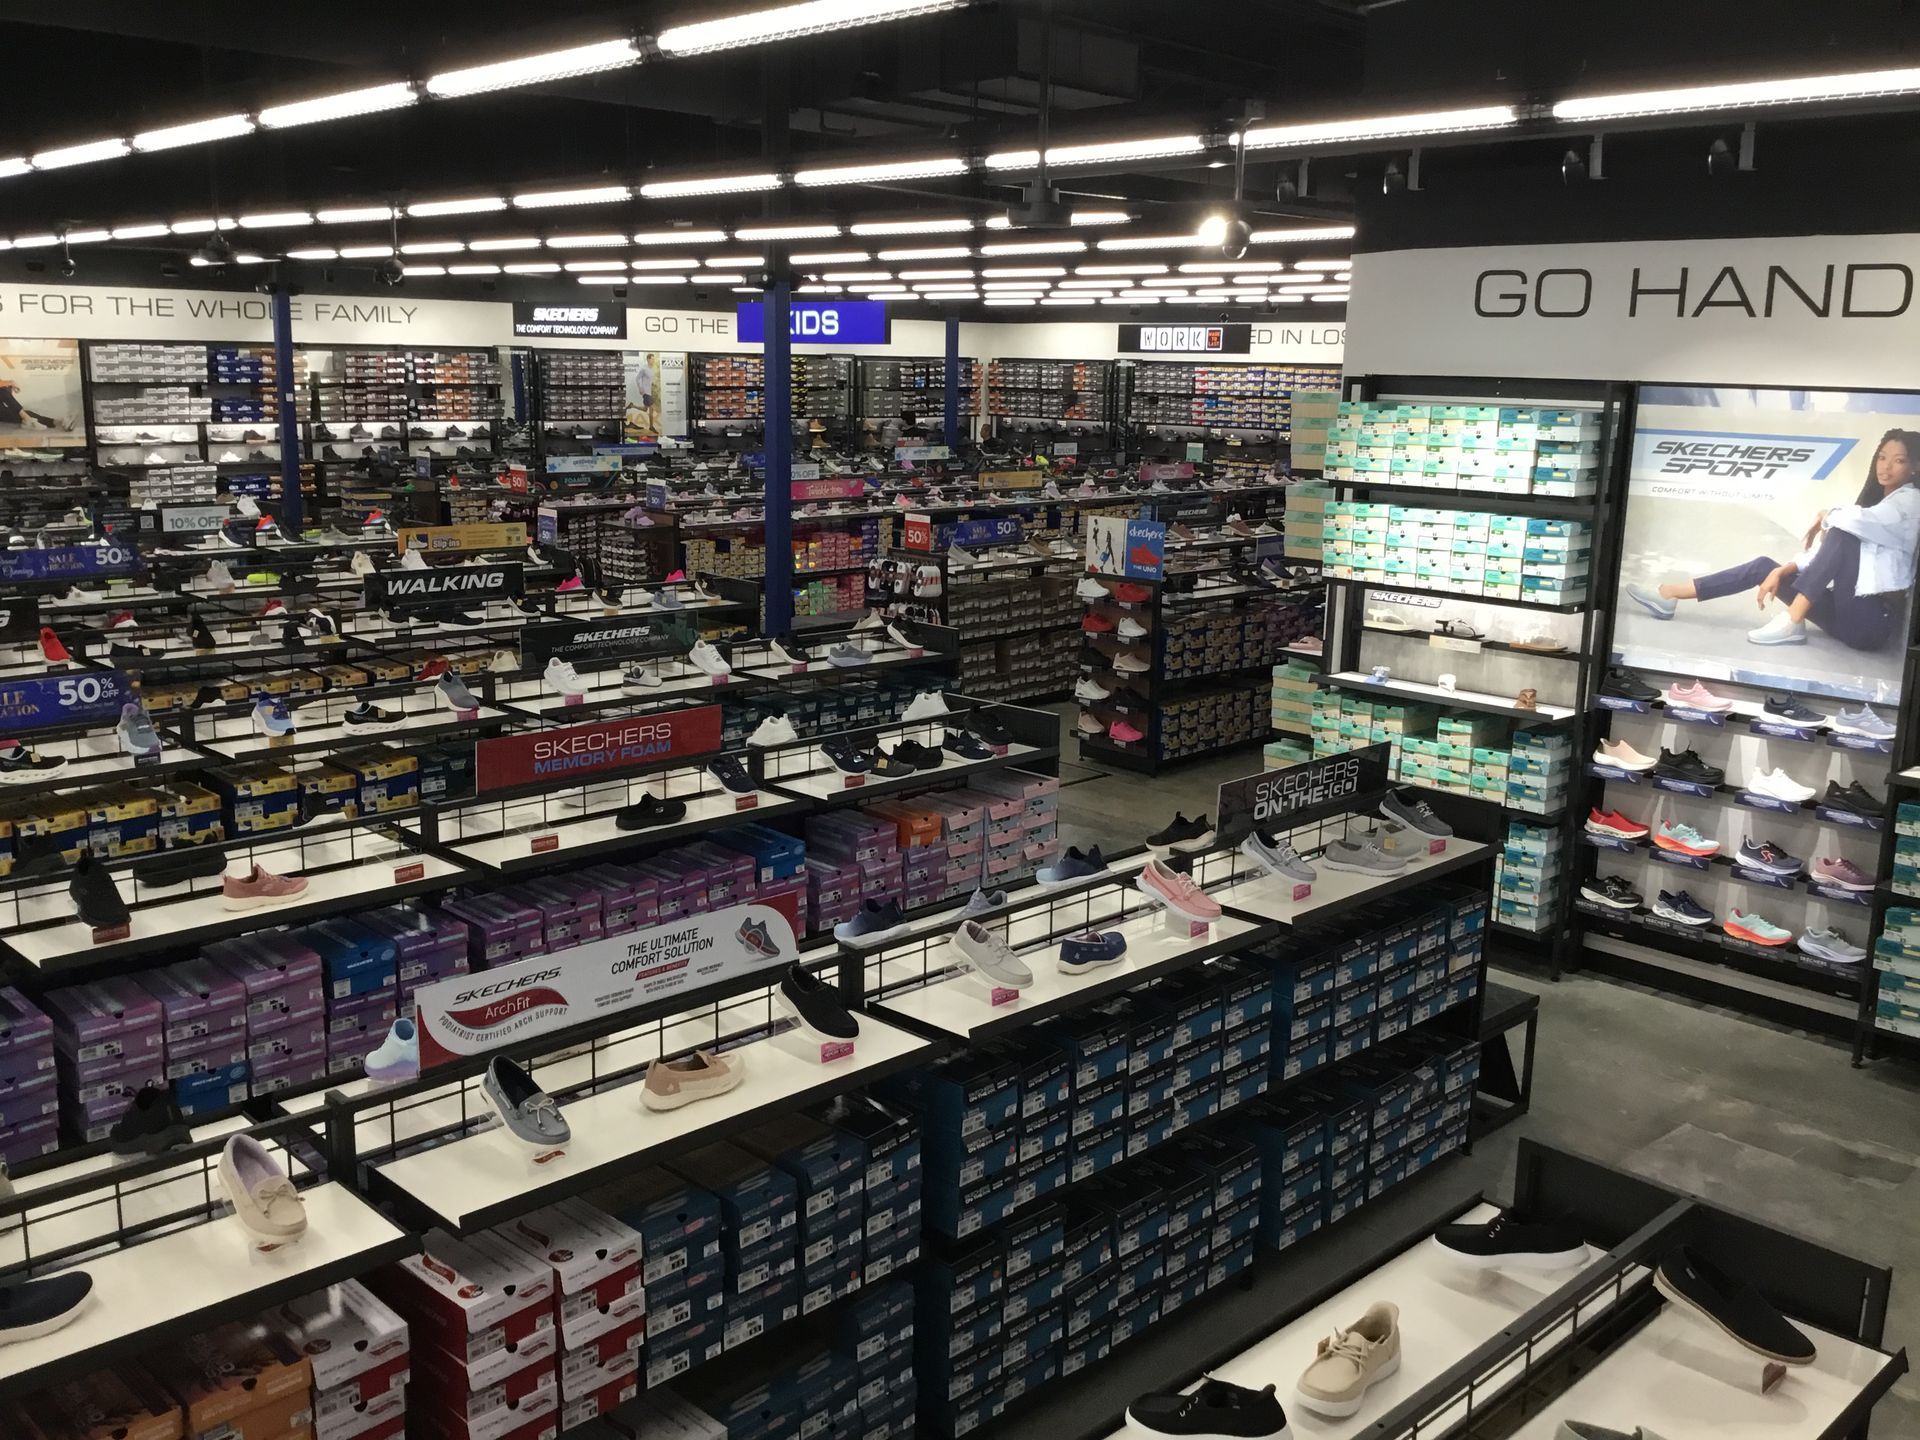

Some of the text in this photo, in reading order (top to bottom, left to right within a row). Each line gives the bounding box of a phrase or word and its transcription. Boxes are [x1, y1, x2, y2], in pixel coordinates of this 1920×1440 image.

[1474, 263, 1914, 318] GO HAND
[19, 293, 93, 315] FOR
[106, 296, 175, 317] THE
[315, 303, 418, 325] FAMILY
[533, 307, 599, 322] SKECHERS
[515, 324, 527, 333] THE
[589, 326, 618, 336] COMPANY
[645, 316, 729, 334] GO THE
[1144, 331, 1202, 347] WORK
[1281, 329, 1302, 344] IN
[1652, 441, 1816, 463] SKECHERS
[1660, 458, 1789, 480] SPORT
[170, 515, 224, 529] 10% OFF
[1129, 525, 1163, 541] skechers
[1142, 566, 1157, 574] UNO
[387, 572, 504, 596] WALKING
[1371, 591, 1443, 609] SKECHERS
[551, 634, 670, 654] THE COMFORT TECHNOLOGY COMPANY
[572, 626, 651, 644] SKECHERS
[101, 689, 120, 699] OFF
[534, 722, 672, 760] SKECHERS
[533, 740, 672, 775] MEMORY FOAM
[1255, 758, 1360, 803] SKECHERS
[627, 927, 699, 957] THE ULTIMATE
[611, 936, 714, 975] COMFORT SOLUTION
[453, 966, 562, 1006] SKECHERS
[438, 1007, 568, 1043] PODIATRIST CERTIFIED ARCH SUPPORT
